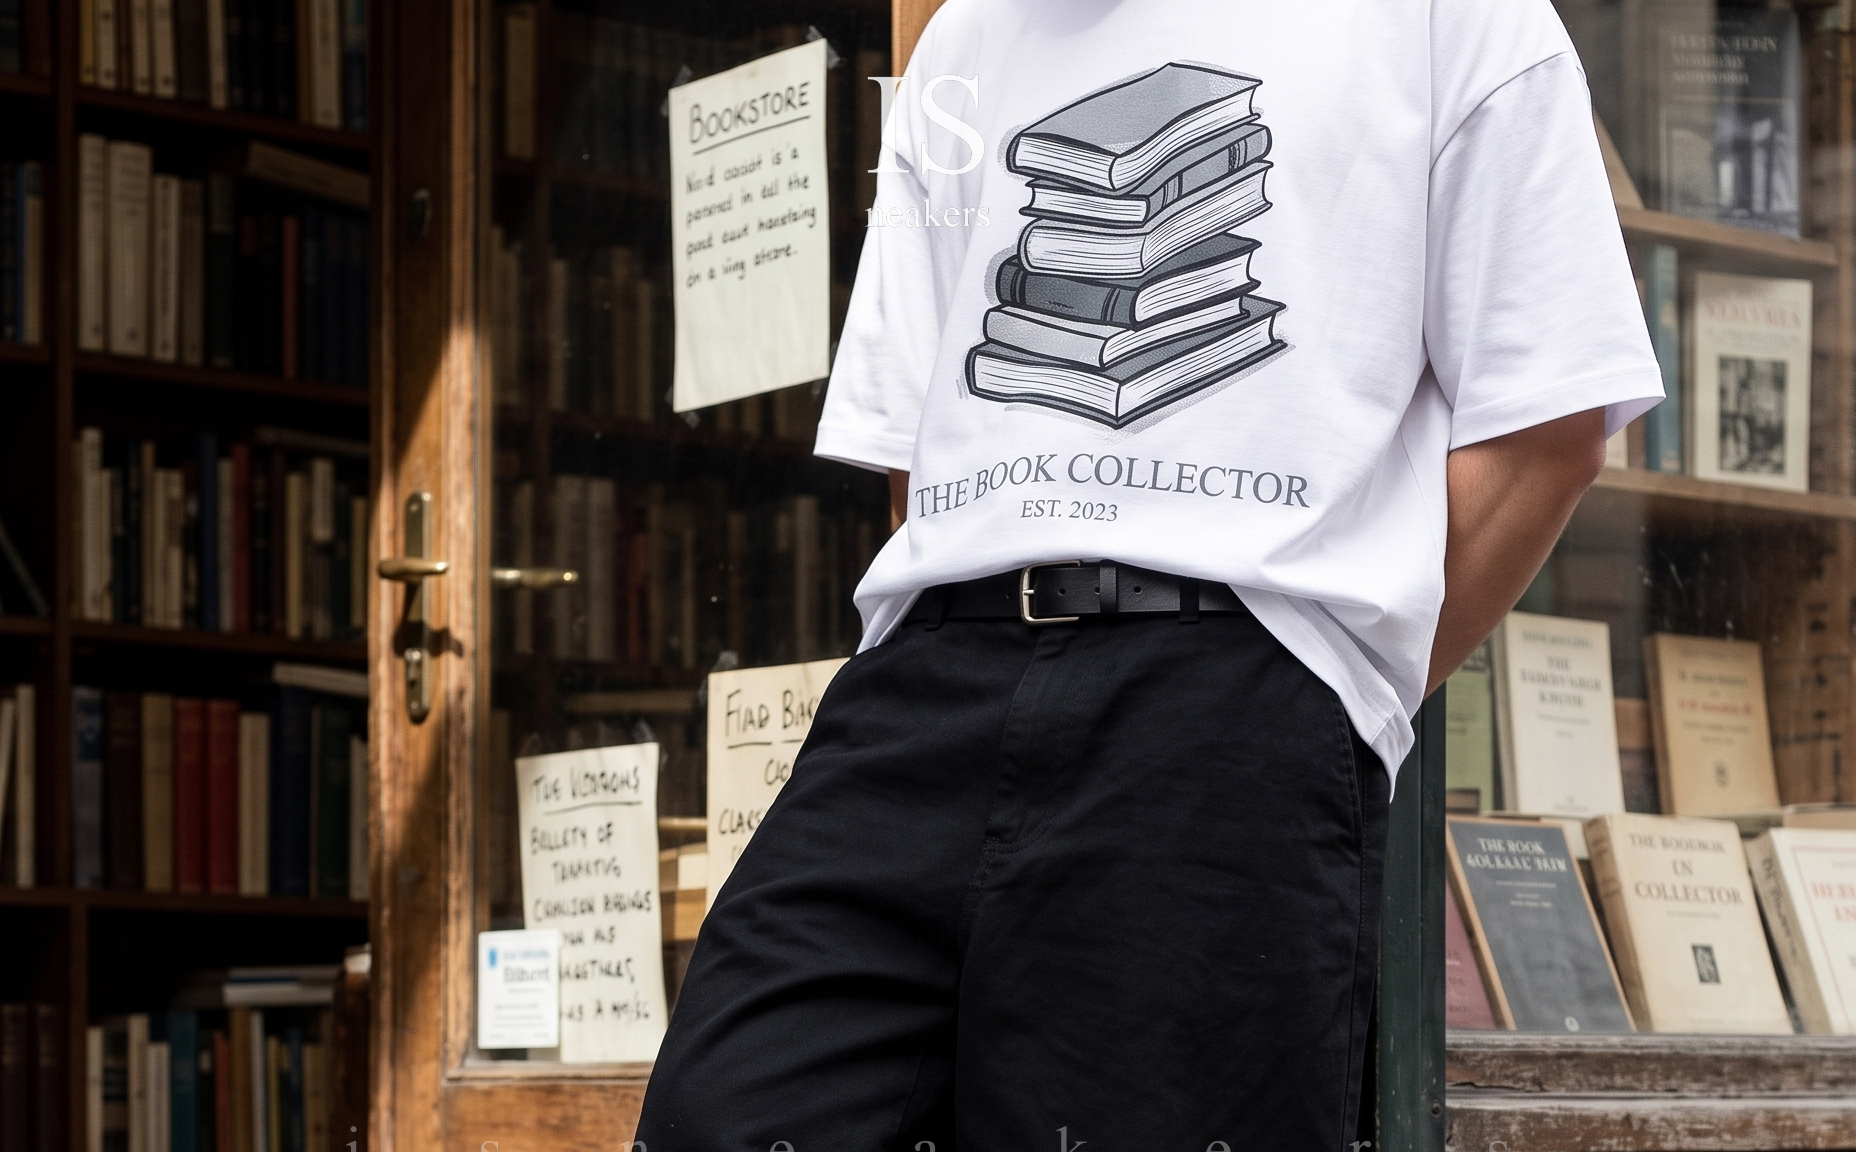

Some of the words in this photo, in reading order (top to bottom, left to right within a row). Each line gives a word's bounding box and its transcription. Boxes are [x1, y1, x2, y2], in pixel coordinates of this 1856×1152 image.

[689, 81, 810, 145] BOOKSTORE
[914, 477, 970, 519] THE
[973, 453, 1059, 502] BOOK
[1066, 452, 1311, 509] COLLECTOR
[1020, 499, 1063, 519] EST.
[1068, 500, 1119, 522] 2023
[1634, 879, 1744, 906] COLLECTOR
